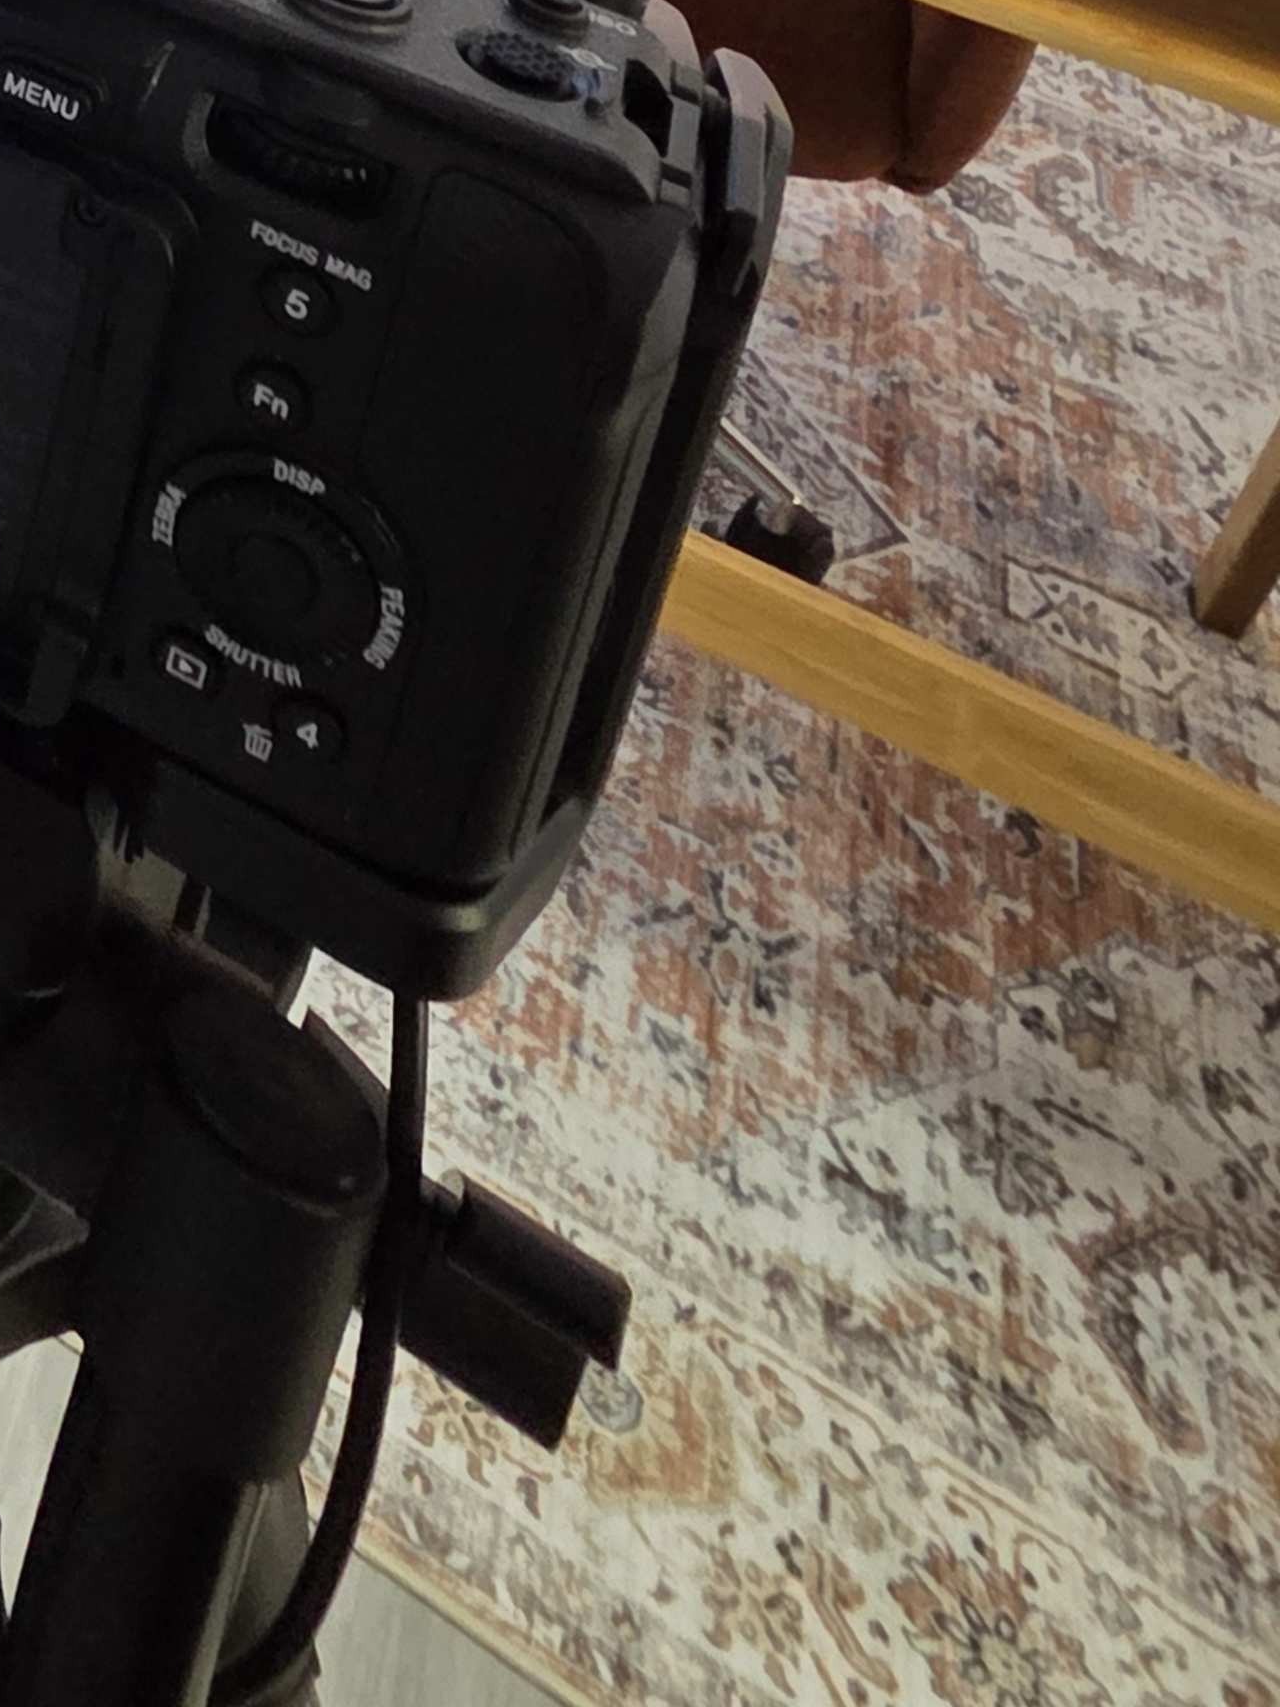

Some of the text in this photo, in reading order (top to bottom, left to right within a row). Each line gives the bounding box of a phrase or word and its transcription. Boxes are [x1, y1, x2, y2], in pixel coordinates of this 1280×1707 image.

[3, 71, 81, 121] MENU
[249, 219, 373, 292] FOCUS MAG
[284, 289, 311, 321] 5
[252, 383, 290, 421] Fn
[272, 458, 326, 496] DISP
[151, 484, 188, 548] ZEBRA
[203, 623, 303, 688] SHUTTER
[296, 721, 320, 749] 4
